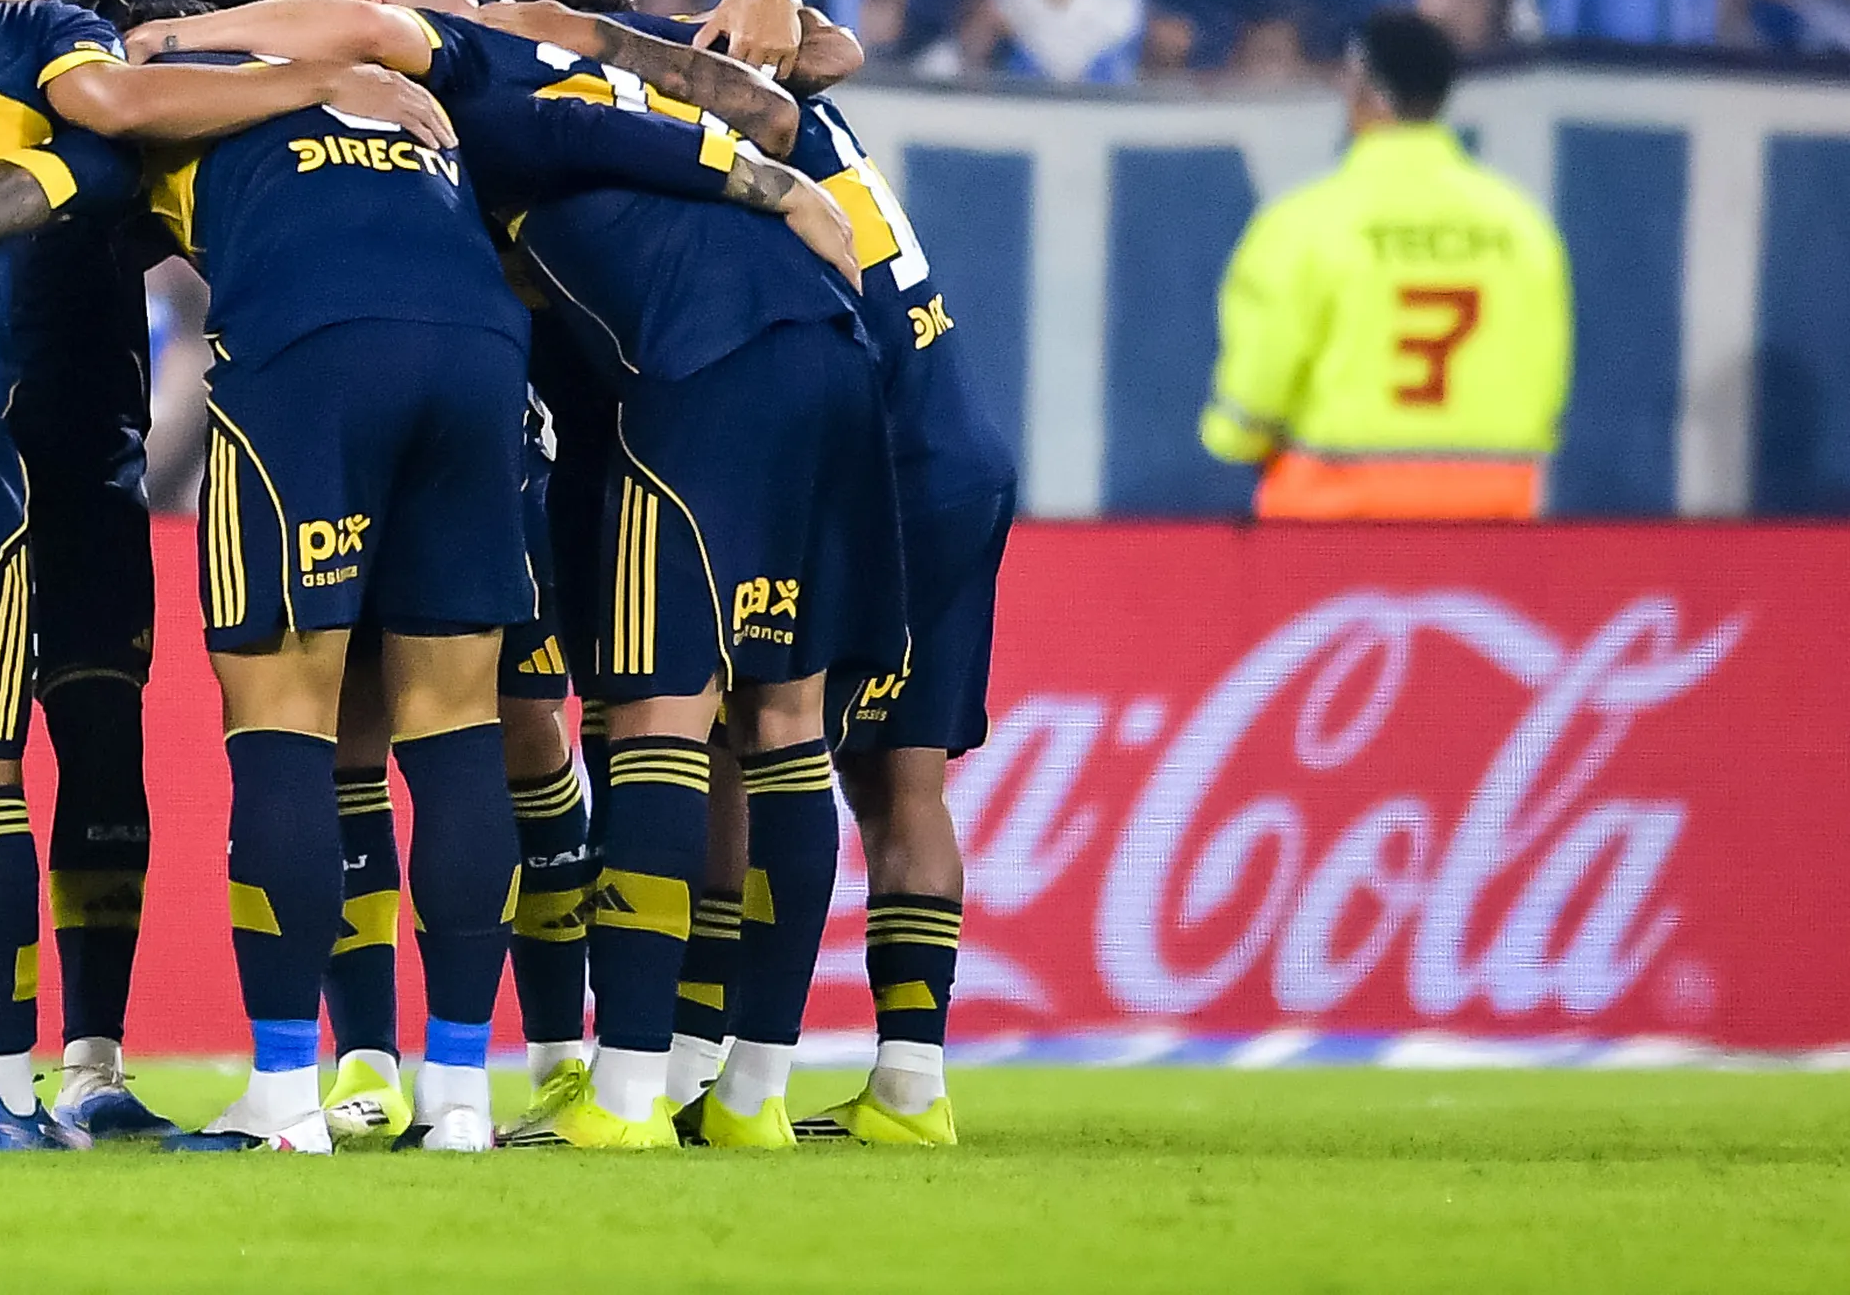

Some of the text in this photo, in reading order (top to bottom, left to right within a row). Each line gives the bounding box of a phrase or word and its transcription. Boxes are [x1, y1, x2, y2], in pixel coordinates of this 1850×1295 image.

[288, 135, 460, 188] DIRECTV
[1362, 222, 1515, 262] TECH
[1396, 287, 1481, 403] 3
